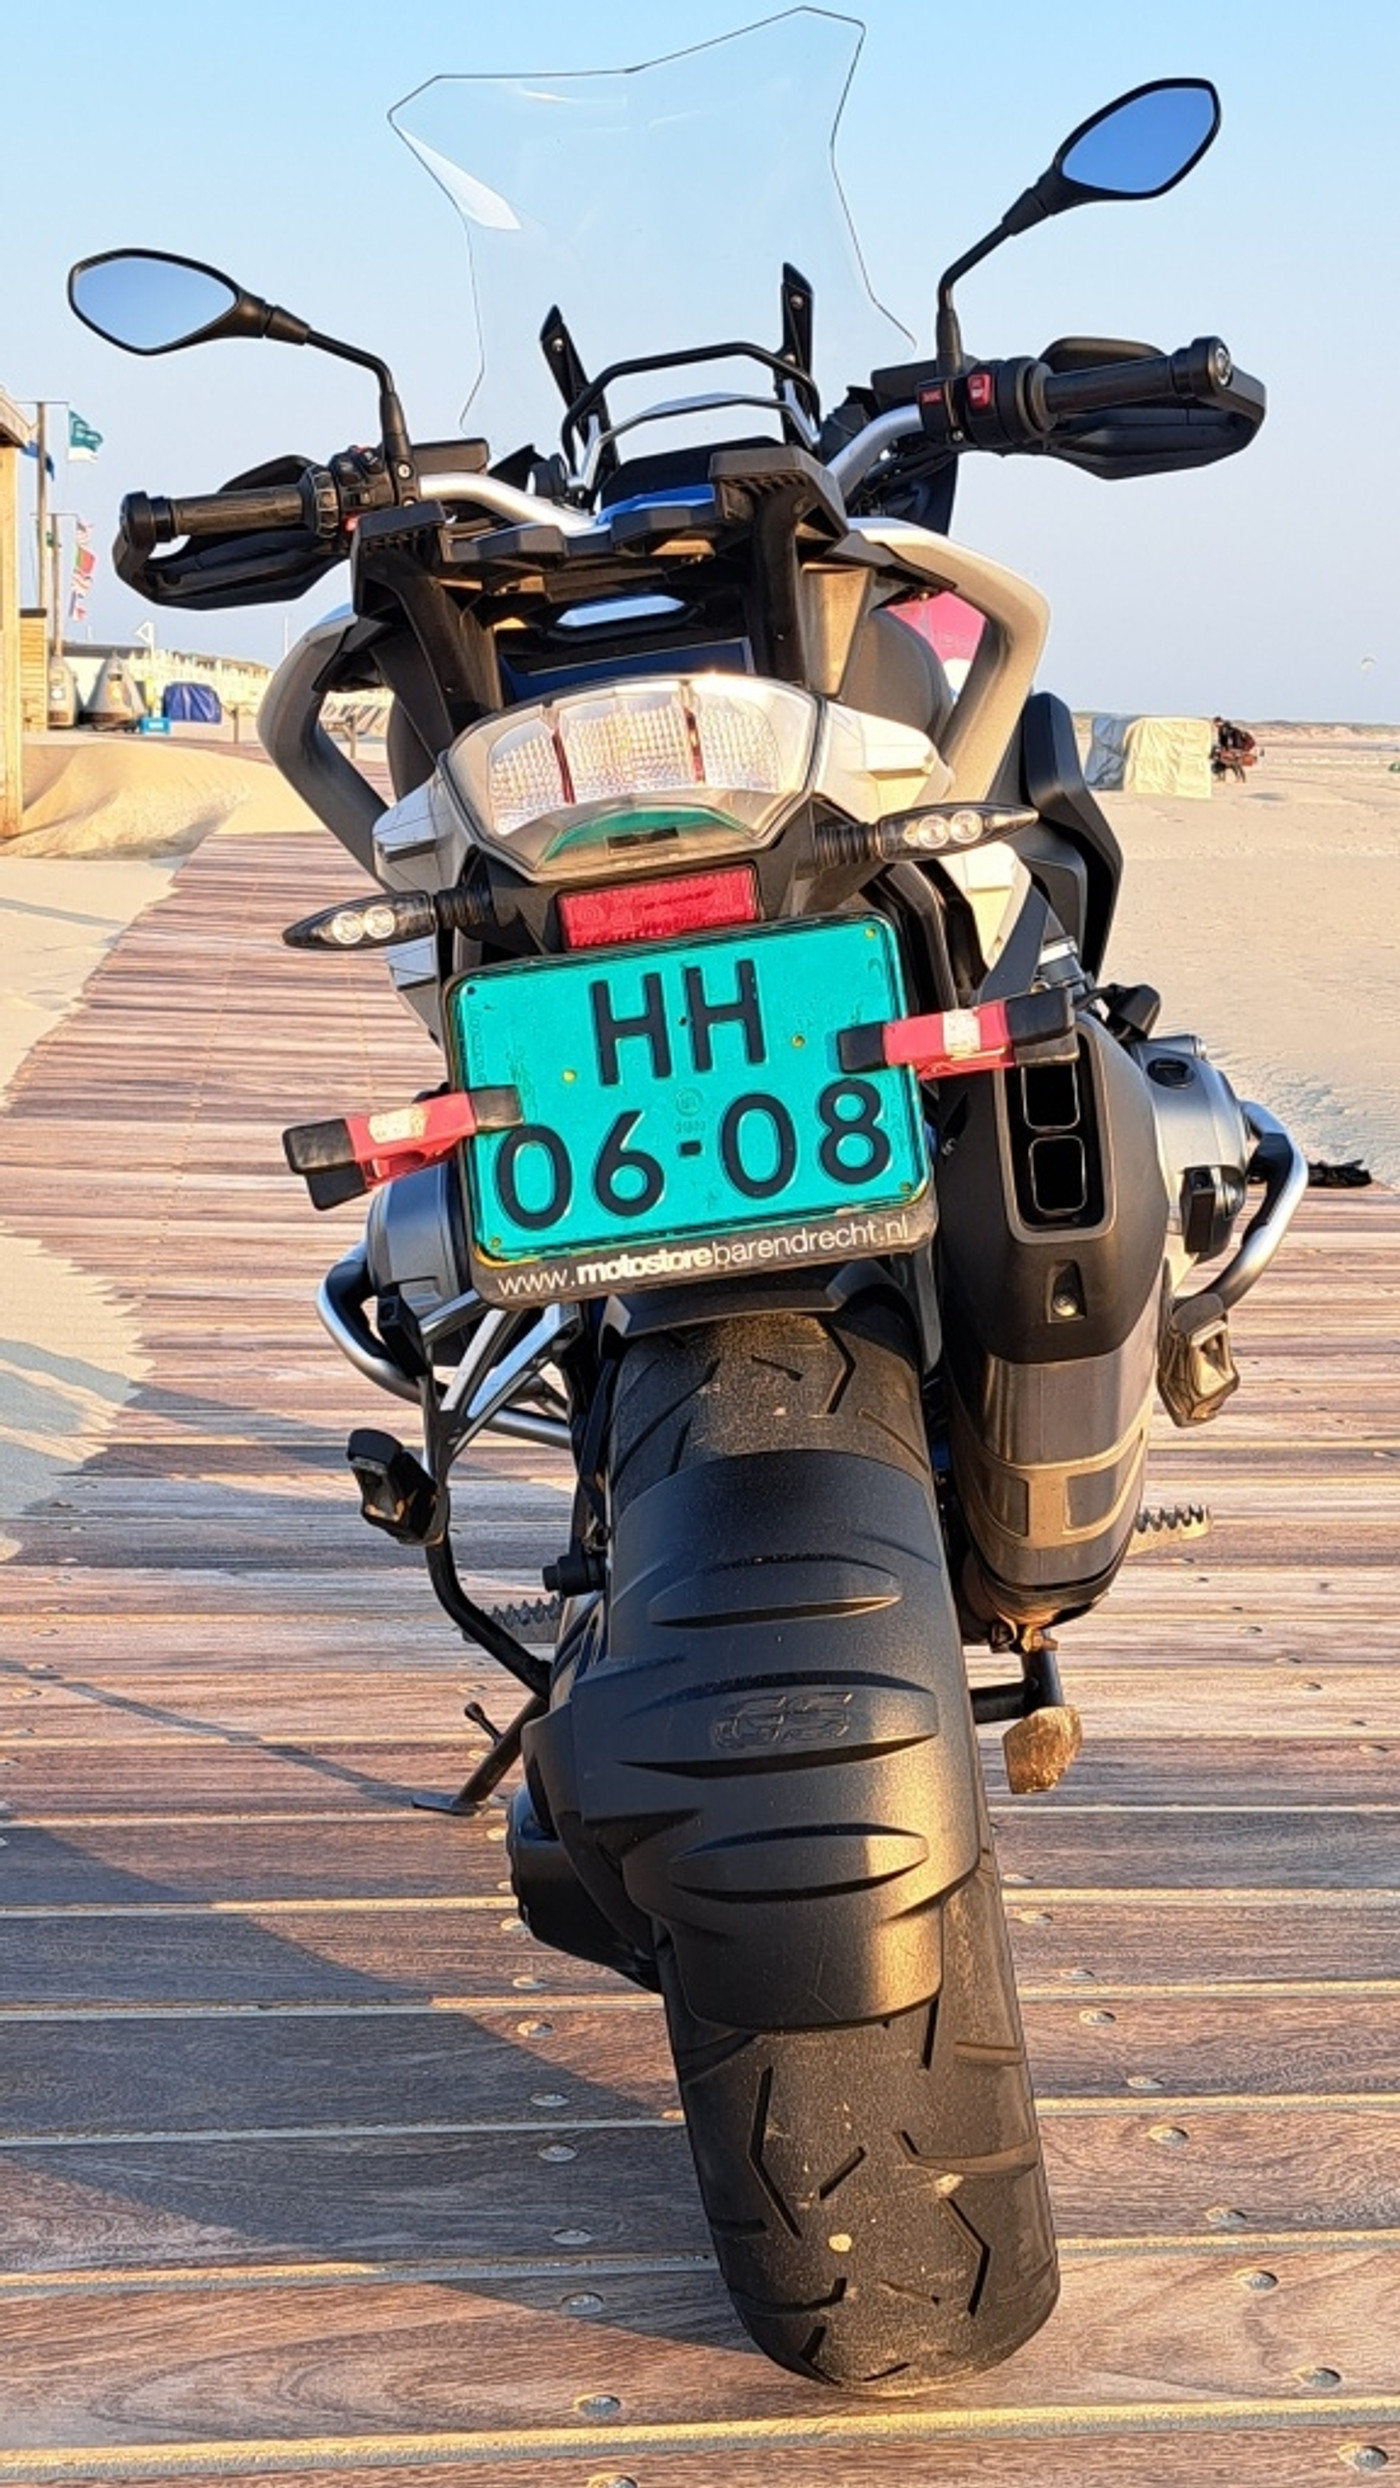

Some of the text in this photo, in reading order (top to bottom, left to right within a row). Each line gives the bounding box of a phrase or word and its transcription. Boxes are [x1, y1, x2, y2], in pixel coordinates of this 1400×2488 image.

[589, 958, 766, 1086] HH
[494, 1078, 892, 1231] 06-08
[497, 1213, 909, 1295] www.motostorebarendrecht.nl
[711, 1691, 853, 1750] GS
